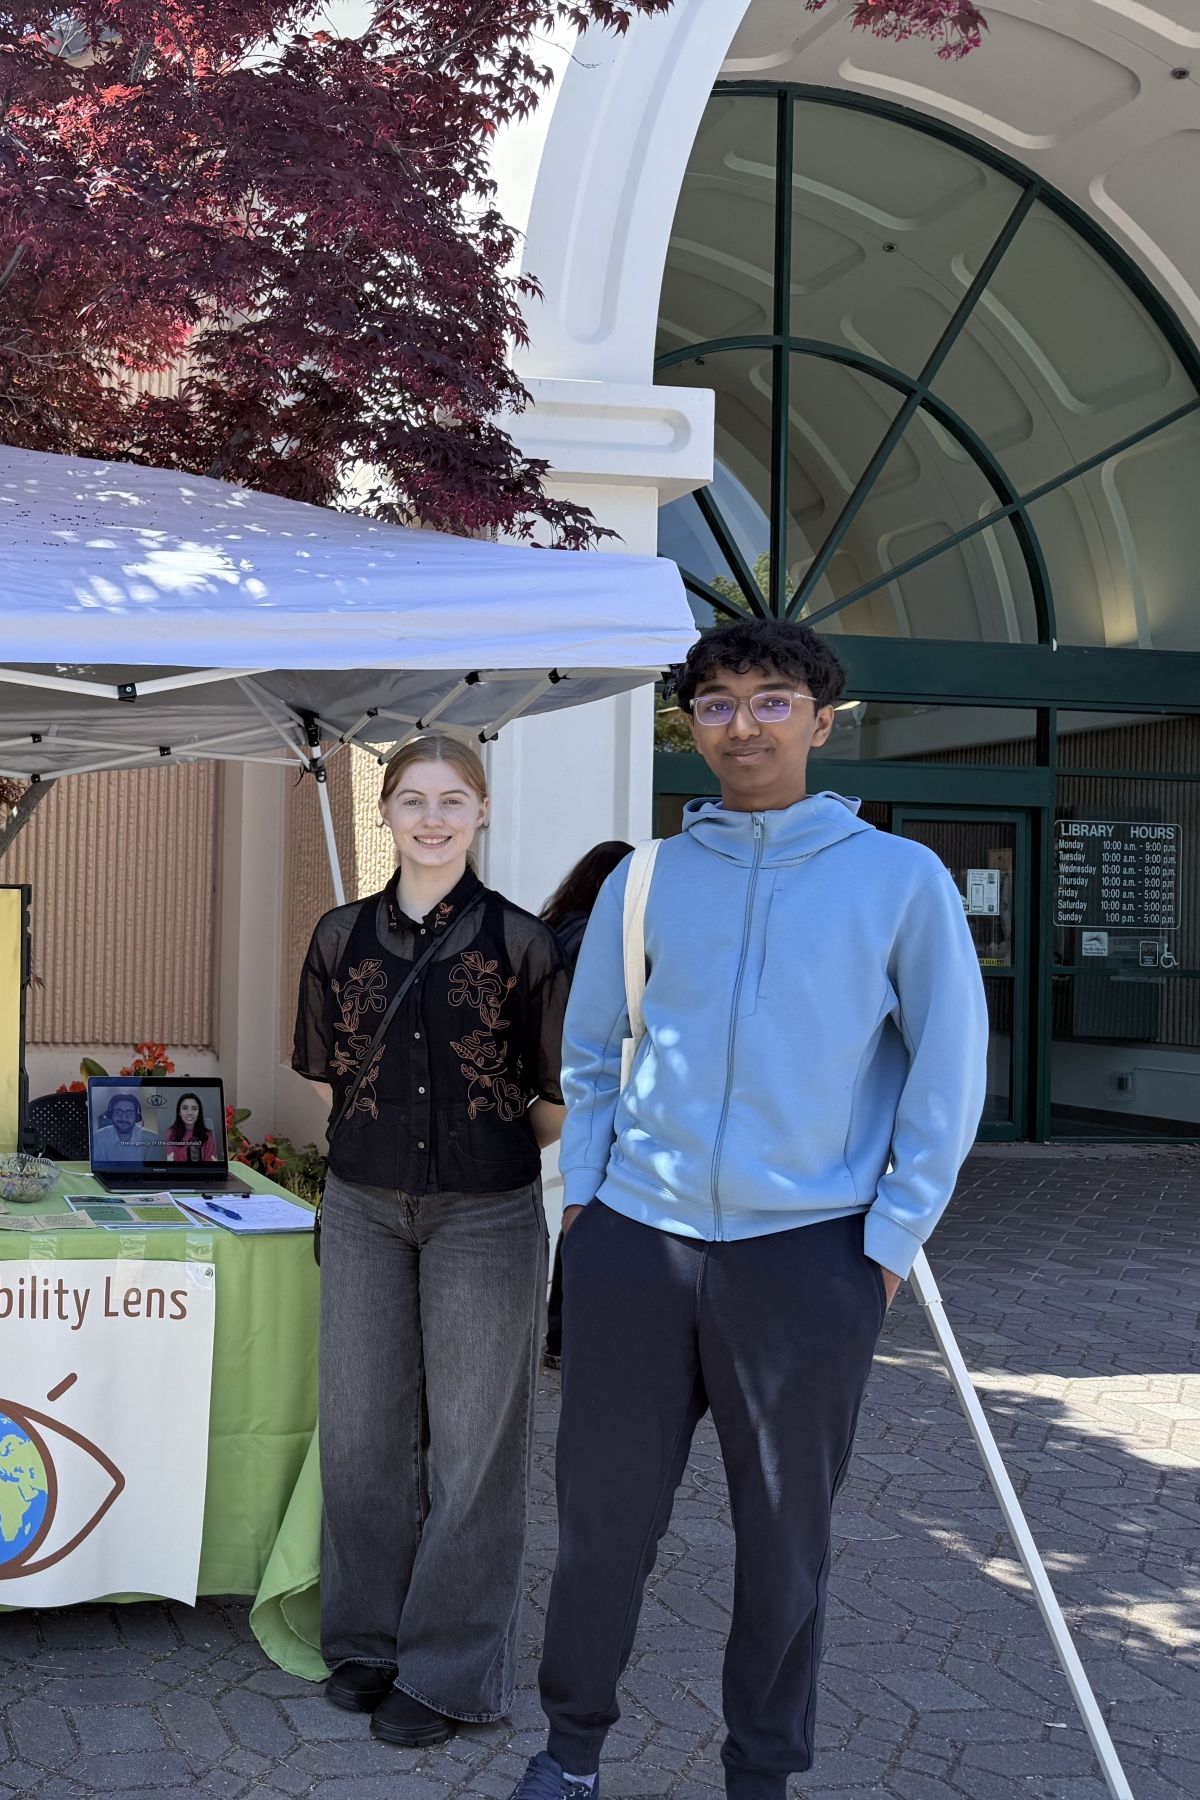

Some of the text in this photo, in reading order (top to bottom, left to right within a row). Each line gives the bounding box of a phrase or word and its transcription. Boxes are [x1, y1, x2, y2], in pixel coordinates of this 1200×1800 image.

[1061, 823, 1175, 840] LIBRARY HOURS
[1058, 839, 1084, 850] Monday
[1103, 841, 1121, 850] 10:00
[1145, 842, 1161, 851] 9:00
[1059, 851, 1085, 862] Tuesday
[1102, 853, 1121, 862] 10:00
[1145, 854, 1161, 863] 9:00
[1059, 863, 1096, 875] Wednesday
[1102, 865, 1120, 874] 10:00
[1144, 866, 1160, 875] 9:00
[1058, 875, 1088, 887] Thursday
[1102, 877, 1120, 886] 10:00
[1144, 878, 1160, 887] 9:00
[1058, 887, 1079, 899] Friday
[1101, 889, 1120, 898] 10:00
[1144, 890, 1160, 899] 5:00
[1058, 899, 1087, 911] Saturday
[1101, 901, 1120, 910] 10:00
[1144, 902, 1160, 912] 5:00
[1057, 911, 1082, 923] Sunday
[1105, 913, 1120, 922] 1:00
[1143, 914, 1159, 923] 5:00
[103, 1275, 189, 1321] Lens
